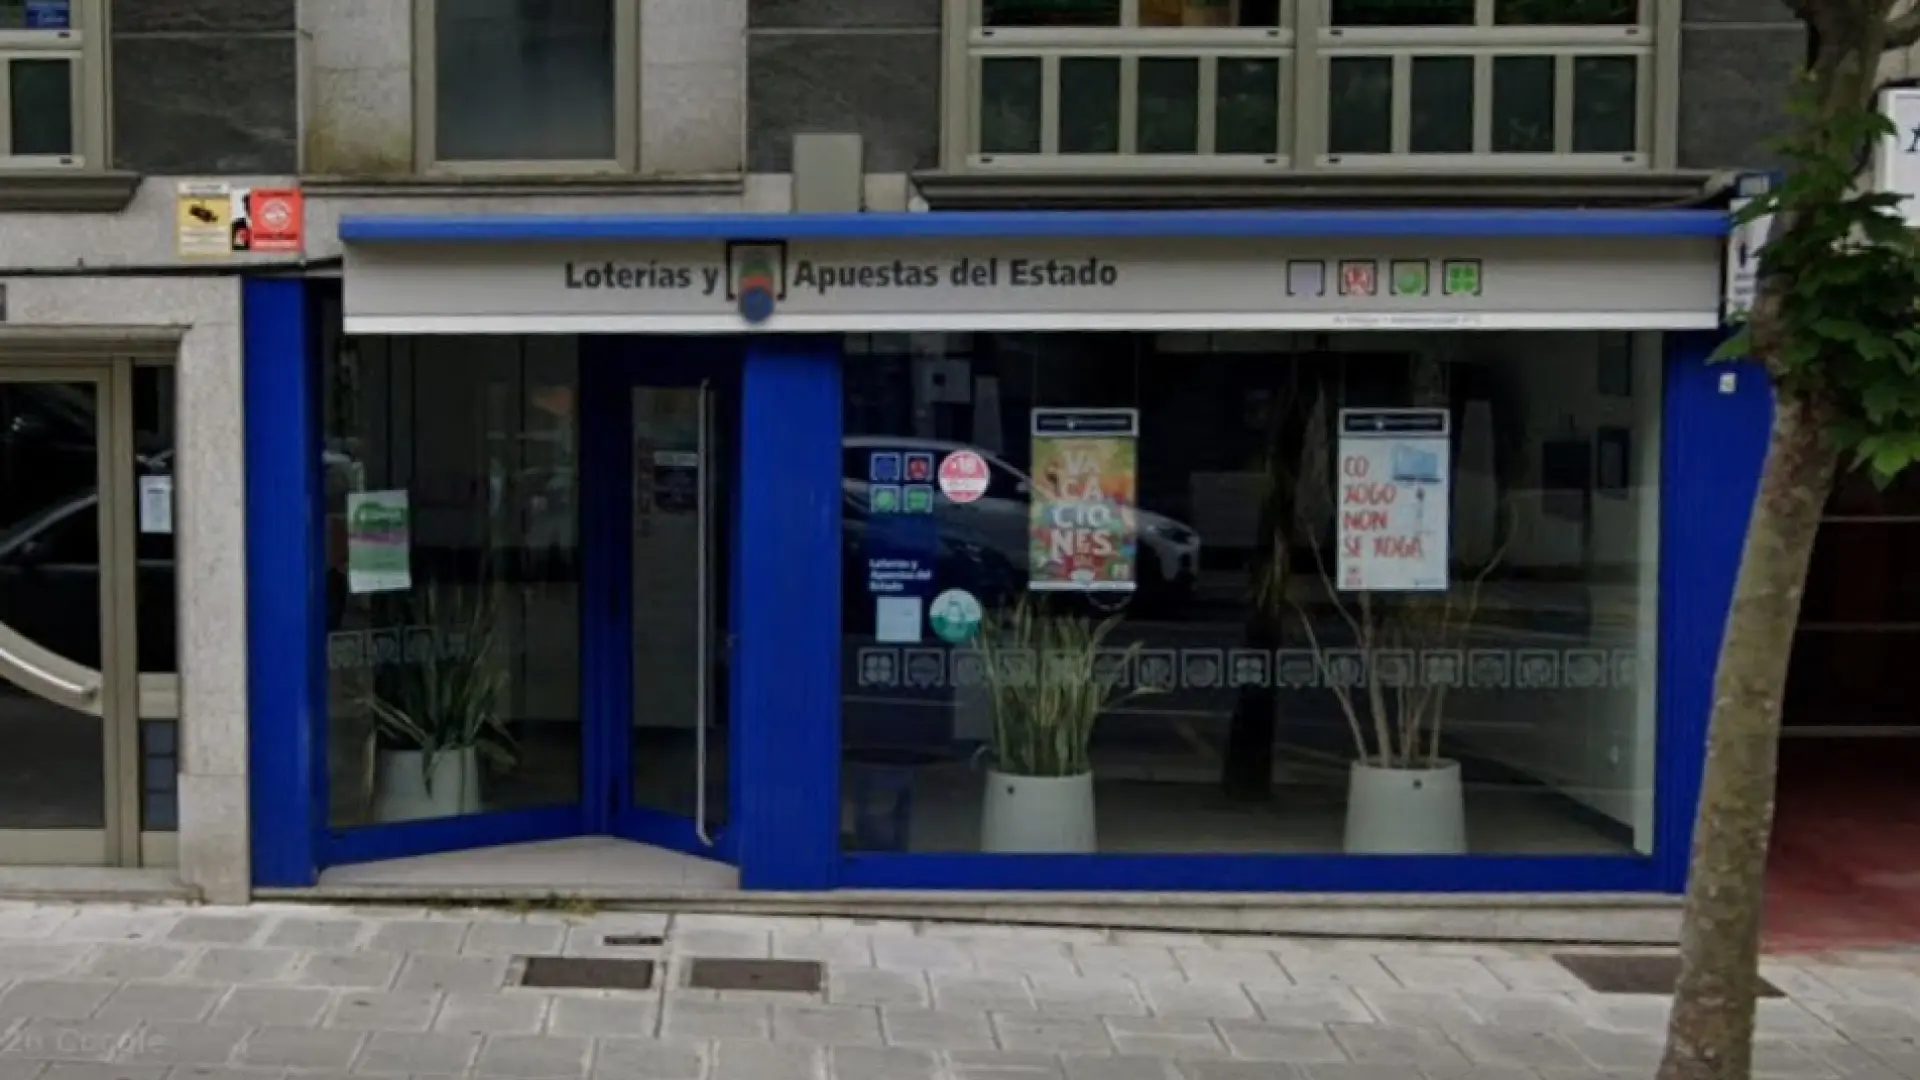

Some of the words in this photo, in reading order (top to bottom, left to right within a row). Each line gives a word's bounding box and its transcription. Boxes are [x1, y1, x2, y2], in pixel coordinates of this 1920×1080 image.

[564, 259, 691, 289] Loterías
[702, 267, 720, 296] y
[793, 258, 939, 295] Apuestas
[951, 257, 998, 287] del
[1009, 257, 1118, 287] Estado
[1053, 504, 1112, 528] CIO
[1051, 528, 1113, 557] NES
